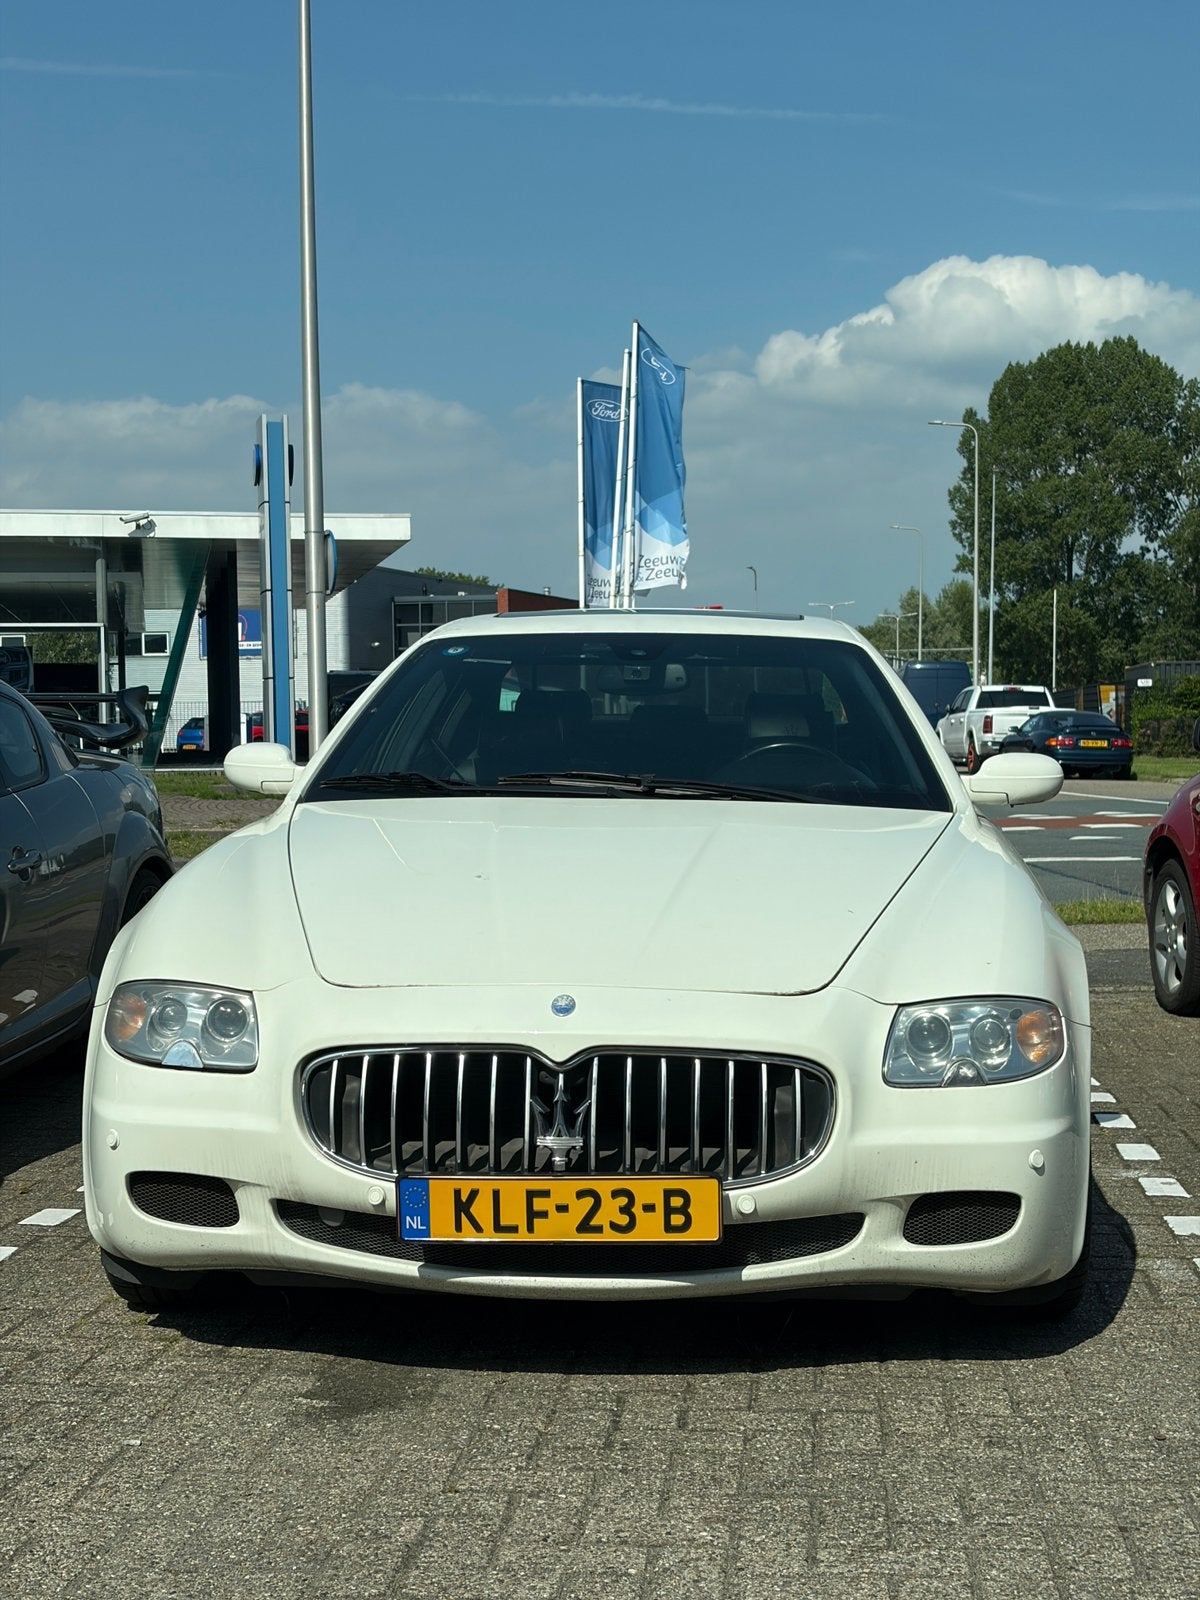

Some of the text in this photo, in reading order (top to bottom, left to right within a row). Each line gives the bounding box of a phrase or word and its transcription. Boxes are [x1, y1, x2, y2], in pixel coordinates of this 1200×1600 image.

[591, 401, 620, 419] Ford
[453, 1187, 693, 1234] KLF-23-B
[405, 1215, 426, 1230] NL
